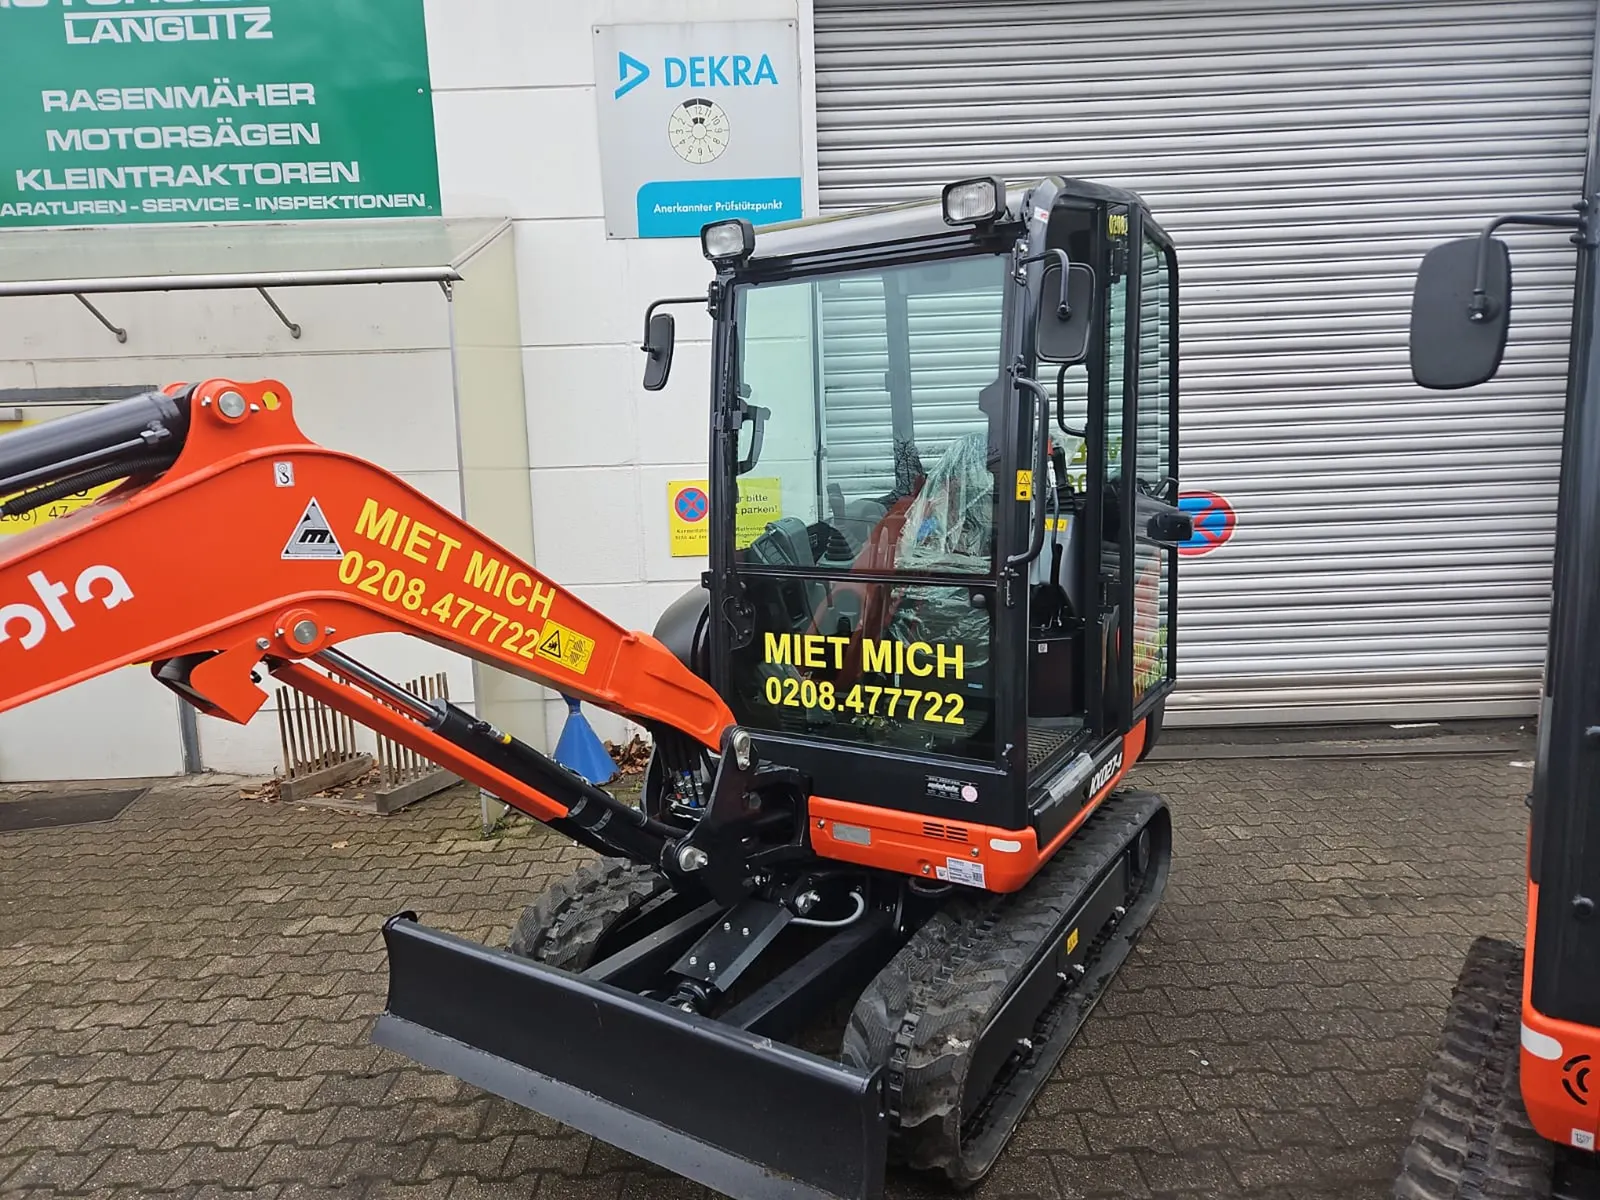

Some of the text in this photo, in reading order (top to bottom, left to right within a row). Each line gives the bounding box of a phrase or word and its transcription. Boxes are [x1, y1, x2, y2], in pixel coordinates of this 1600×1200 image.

[64, 7, 273, 44] LANGLITZ
[664, 53, 779, 88] DEKRA
[41, 77, 316, 112] RASENMÄHER
[46, 117, 321, 152] MOTORSÄGEN
[16, 160, 360, 192] KLEINTRAKTOREN
[142, 197, 239, 213] SERVICE
[255, 193, 426, 211] INSPEKTIONEN
[653, 199, 783, 214] Anerkannter Prüfstützpunkt
[741, 505, 778, 516] parken!
[354, 497, 556, 619] MIET MICH
[338, 550, 541, 659] 0208.477722
[764, 632, 964, 680] MIET MICH
[765, 676, 965, 725] 0208.477722
